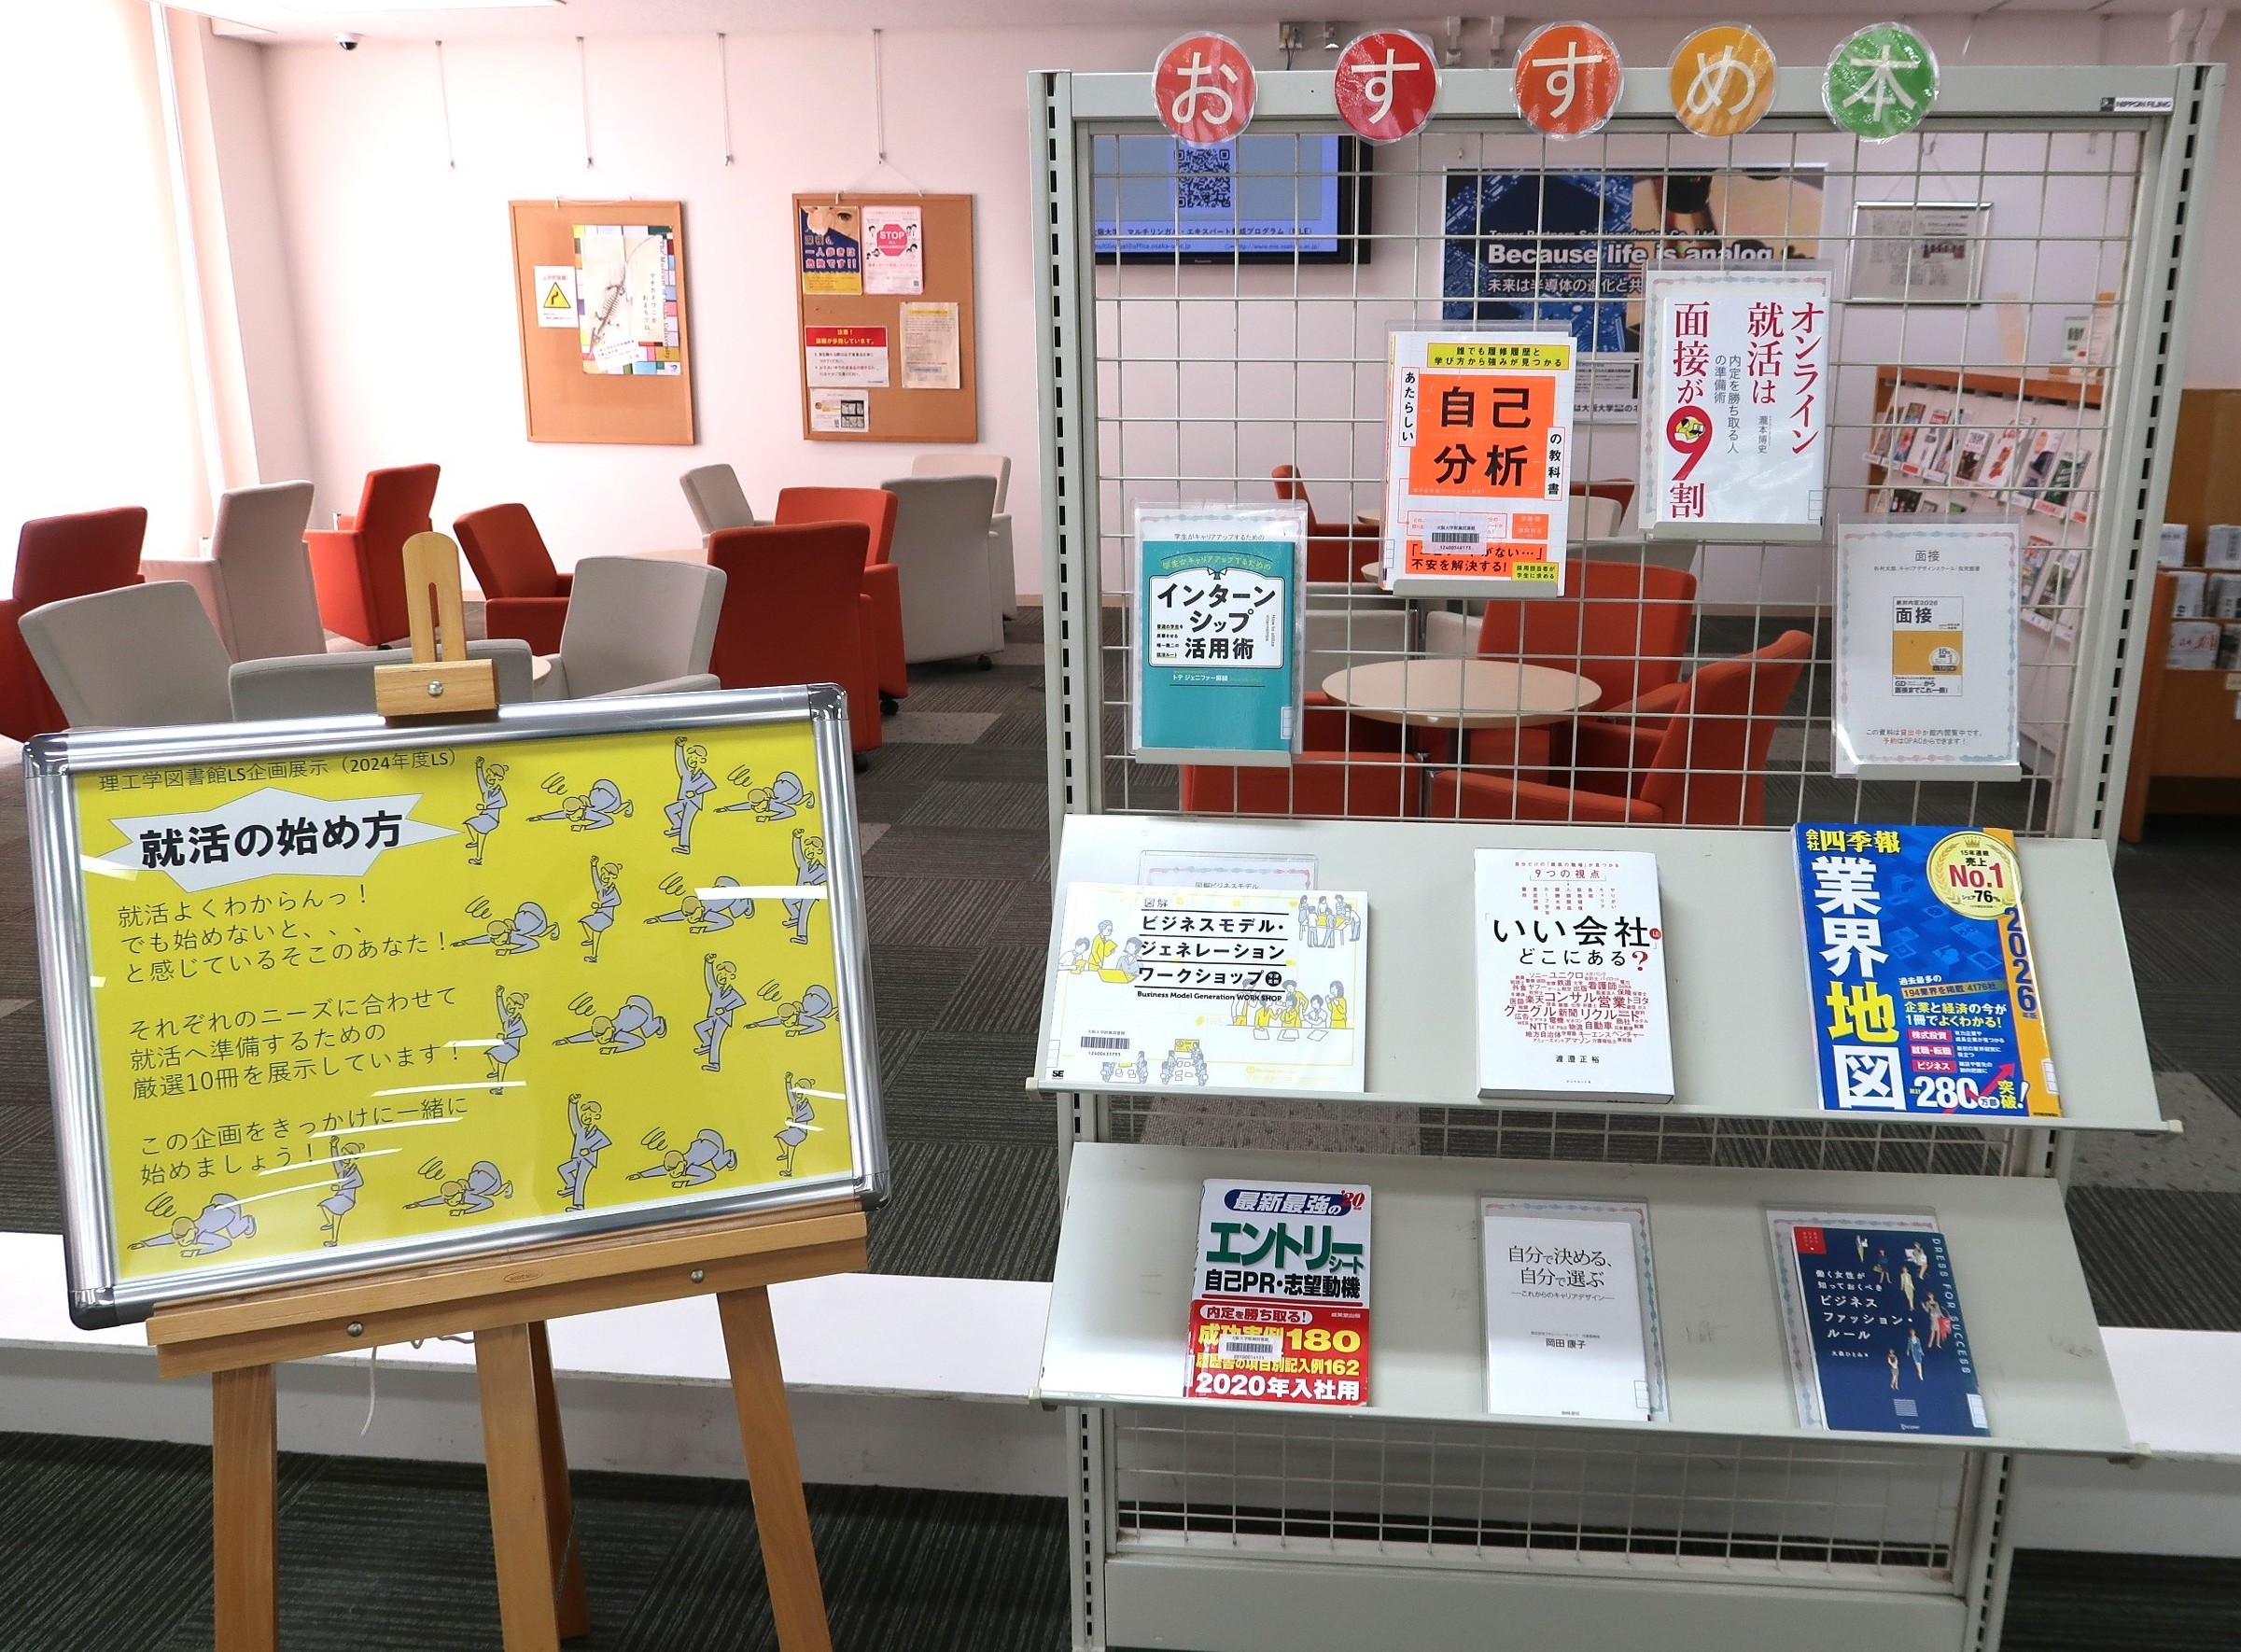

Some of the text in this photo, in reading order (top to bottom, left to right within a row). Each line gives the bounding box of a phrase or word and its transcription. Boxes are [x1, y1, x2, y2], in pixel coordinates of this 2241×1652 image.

[879, 231, 904, 240] STOP
[805, 247, 856, 257] 一人歩きは
[1489, 244, 1773, 263] Because life is analog
[1488, 278, 1642, 293] 未来は半導体の進化と共
[1456, 346, 1541, 357] 誰でも履修履歴と
[1747, 301, 1785, 404] 就活は
[1434, 357, 1562, 367] 学び方から強みが見つかる
[1714, 356, 1727, 404] の準備術
[1790, 301, 1825, 455] オンライン
[1402, 371, 1416, 441] あたらしい
[1440, 385, 1531, 428] 自己
[1667, 301, 1713, 519] 面接が9割
[1728, 355, 1742, 455] 内定を勝ち取る人
[1433, 443, 1528, 486] 分析
[1548, 433, 1562, 497] の教科書
[1174, 533, 1265, 541] 学生がキャリアアップするための
[1411, 559, 1507, 572] 不安を解決する!
[1915, 550, 1940, 562] 面接
[1157, 582, 1276, 608] インターン
[1189, 609, 1254, 634] シップ
[1896, 608, 1932, 623] 面接
[1184, 637, 1254, 660] 活用術
[140, 809, 403, 868] 就活の始め方
[1966, 858, 1987, 866] 売上
[1534, 869, 1600, 878] 9つの視点
[1949, 863, 2004, 889] No.1
[118, 884, 367, 928] 就活よくわからんっ！
[1143, 916, 1283, 933] ビジネスモデル・
[120, 917, 363, 956] でも始めないと、、、
[126, 931, 447, 983] と感じているそこのあなた！
[1142, 941, 1284, 959] ジェネレーション
[1520, 948, 1648, 971] どこにある?
[2004, 907, 2038, 1013] 2026
[1139, 967, 1264, 986] ワークショップ
[1811, 856, 1907, 1111] 業界地図
[1898, 974, 1941, 986] 過去最多の
[1526, 995, 1544, 1003] 楽天
[1545, 992, 1596, 1002] コンサル
[1903, 986, 1965, 998] 194業界を掲載
[1505, 1004, 1557, 1017] グーグル
[1598, 996, 1626, 1008] 営業
[1905, 1001, 2007, 1015] 企業と経済の今が
[130, 986, 457, 1041] それぞれのニーズに合わせて
[1559, 1008, 1577, 1017] 新聞
[1581, 1008, 1639, 1022] リクルート
[1905, 1014, 2002, 1029] 1冊でよくわかる!
[1586, 1021, 1613, 1030] 自動車
[1912, 1030, 1948, 1040] 株式投資
[130, 1022, 386, 1071] 就活へ準備するための
[1912, 1045, 1952, 1056] 就職・転職
[133, 1043, 460, 1100] 厳選10冊を展示しています！
[1917, 1062, 1951, 1071] ビジネス
[1914, 1076, 2030, 1110] 280 万部 突破!
[142, 1096, 469, 1155] この企画をきっかけに一緒に
[141, 1142, 315, 1185] 始めましょう！
[1234, 1191, 1342, 1215] 最新最強の
[1206, 1222, 1365, 1274] エントリー シート
[1509, 1245, 1612, 1267] 自分で決める、
[1205, 1268, 1361, 1298] 自己PR・志望動機
[1520, 1267, 1604, 1288] 自分で選ぶ
[1815, 1269, 1865, 1280] 働く女性が
[1817, 1281, 1883, 1292] 知っておくべき
[1821, 1295, 1878, 1308] ビジネス
[1932, 1238, 1971, 1375] DRESS FOR SUCCESS
[1207, 1307, 1306, 1323] 内定を勝ち取る!
[1824, 1312, 1912, 1325] ファッション・
[1546, 1338, 1564, 1348] 岡田
[1828, 1329, 1870, 1340] ルール
[1195, 1372, 1360, 1402] 2020年入社用
